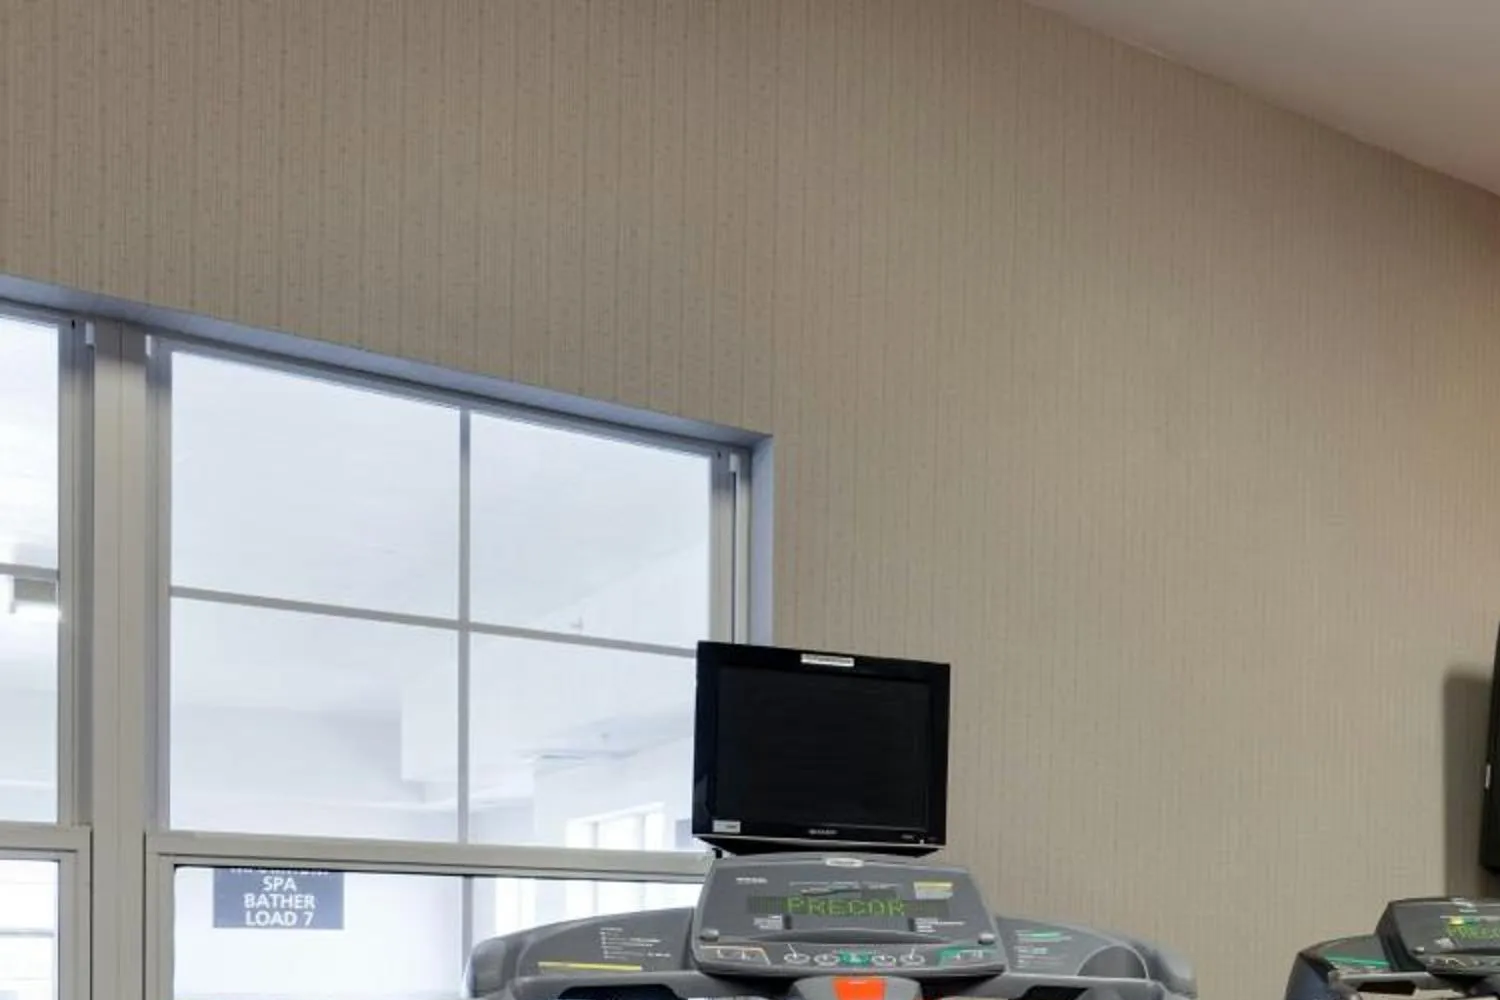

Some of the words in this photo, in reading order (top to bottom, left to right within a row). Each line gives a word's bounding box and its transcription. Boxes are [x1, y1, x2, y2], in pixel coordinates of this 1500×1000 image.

[262, 876, 298, 892] SPA
[243, 893, 316, 909] BATHER
[787, 896, 905, 916] PRECOR
[245, 911, 298, 926] LOAD
[304, 911, 315, 926] 7
